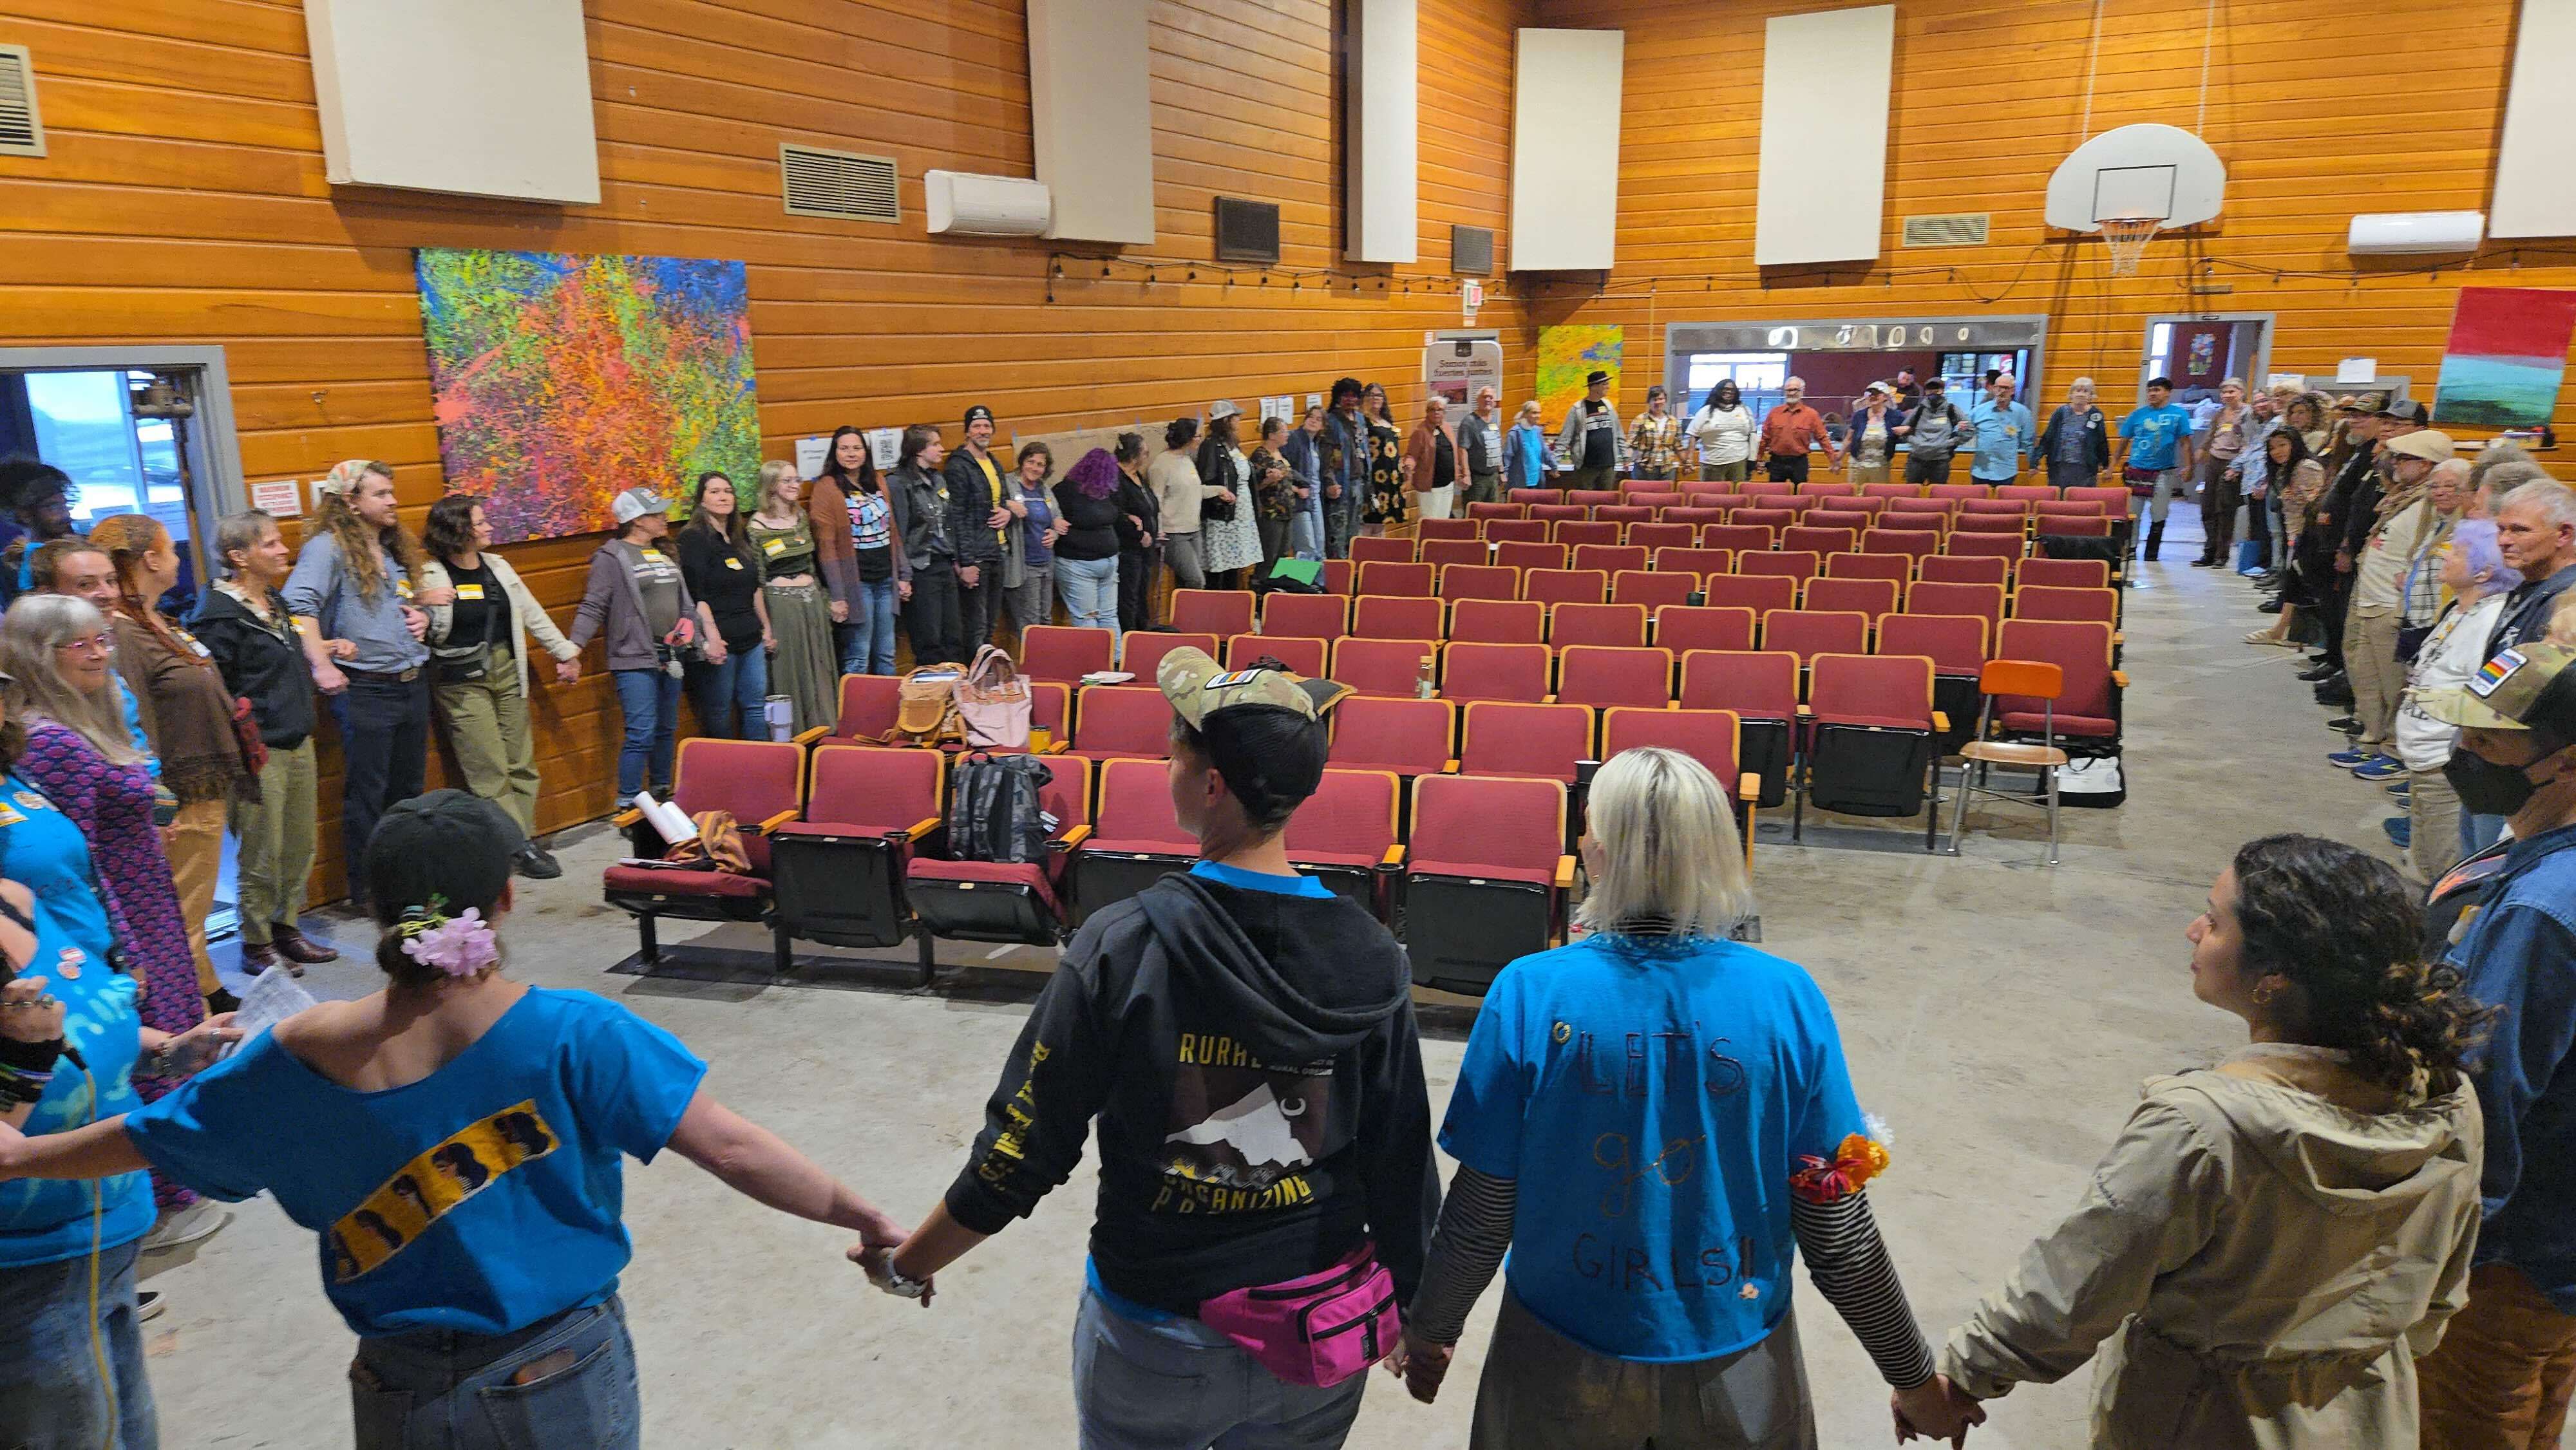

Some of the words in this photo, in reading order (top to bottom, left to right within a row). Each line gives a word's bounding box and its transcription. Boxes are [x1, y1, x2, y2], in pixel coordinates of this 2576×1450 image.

[1439, 359, 1467, 368] Somos
[1580, 1020, 1745, 1095] LET'S
[1593, 1132, 1707, 1218] go
